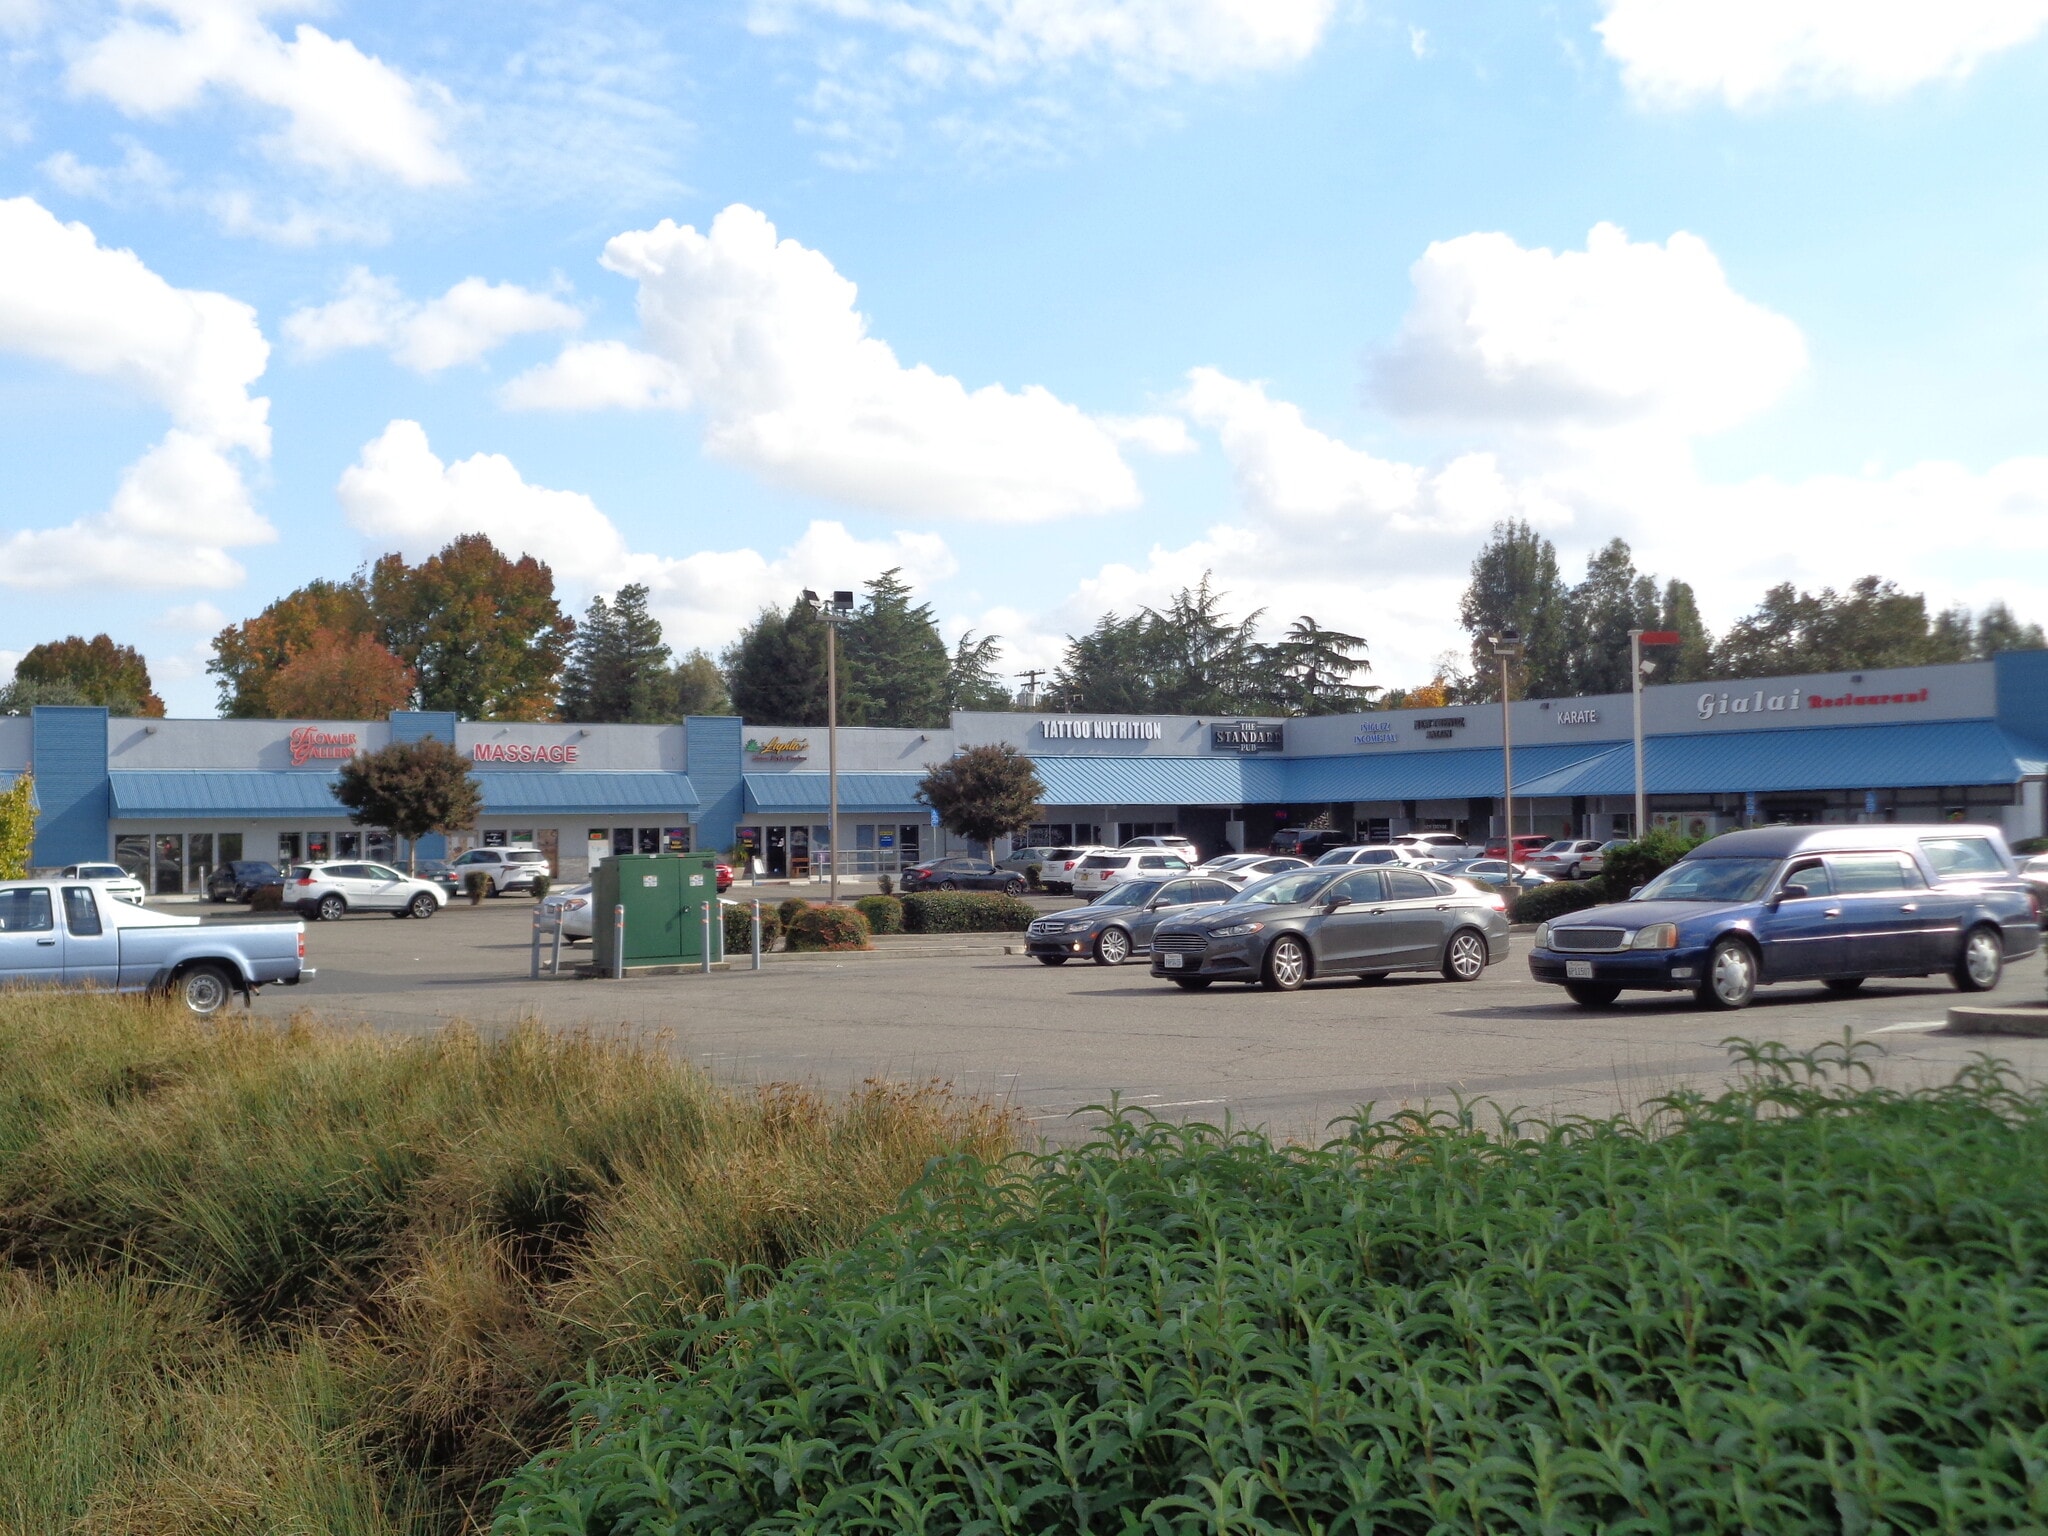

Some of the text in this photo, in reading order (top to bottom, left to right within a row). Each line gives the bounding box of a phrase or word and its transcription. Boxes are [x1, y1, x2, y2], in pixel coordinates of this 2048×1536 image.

[1697, 688, 1800, 720] Gialai
[1240, 722, 1256, 731] THE
[1557, 710, 1596, 725] KARATE
[290, 725, 357, 748] FLOWER
[1042, 720, 1162, 740] TATTOO NUTRITION
[1216, 730, 1281, 743] STANDARD
[291, 744, 358, 766] GALLERY
[473, 743, 577, 763] MASSAGE
[1240, 743, 1257, 752] PUB
